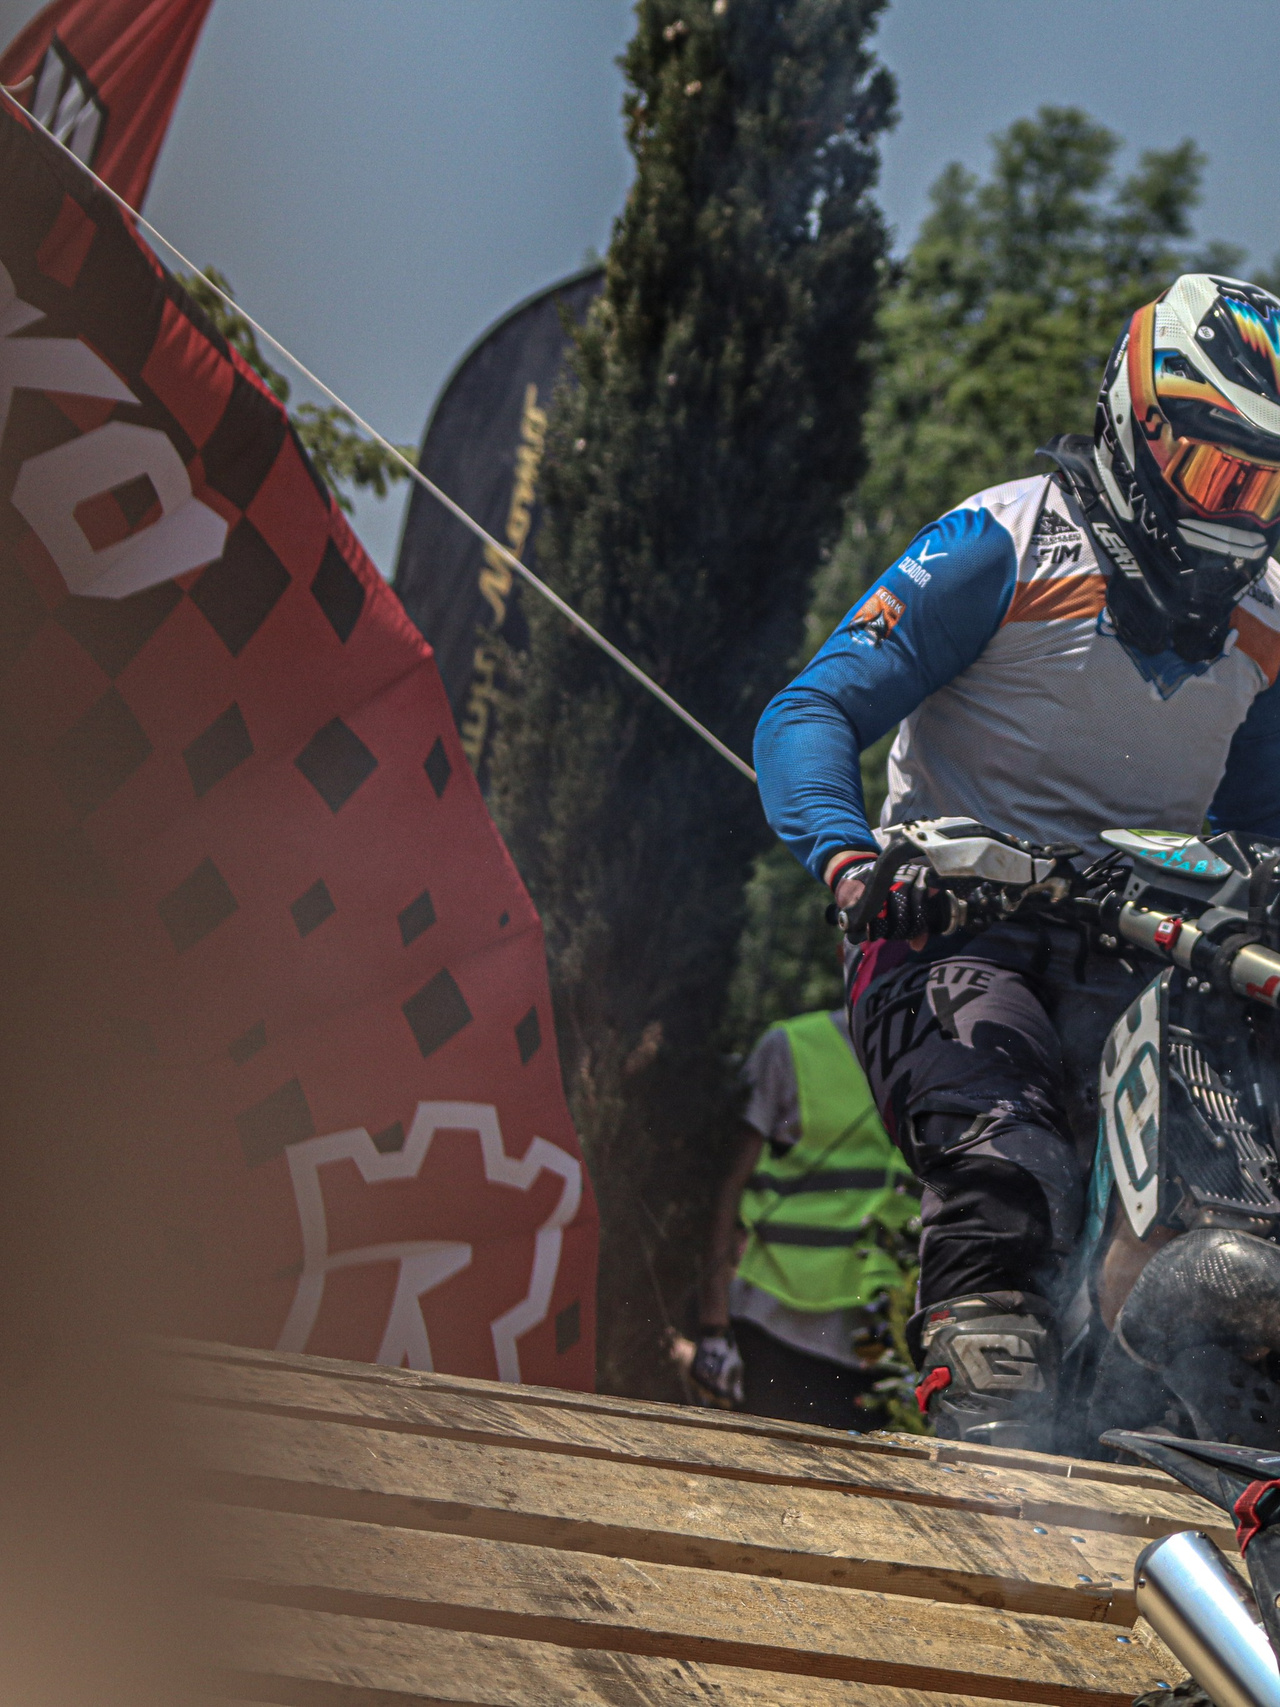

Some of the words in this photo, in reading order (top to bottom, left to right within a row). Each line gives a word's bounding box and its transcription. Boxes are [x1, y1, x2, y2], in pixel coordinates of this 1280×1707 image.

[1092, 522, 1144, 578] LEATT
[898, 556, 932, 588] CAZADOR
[1163, 859, 1209, 873] LAB
